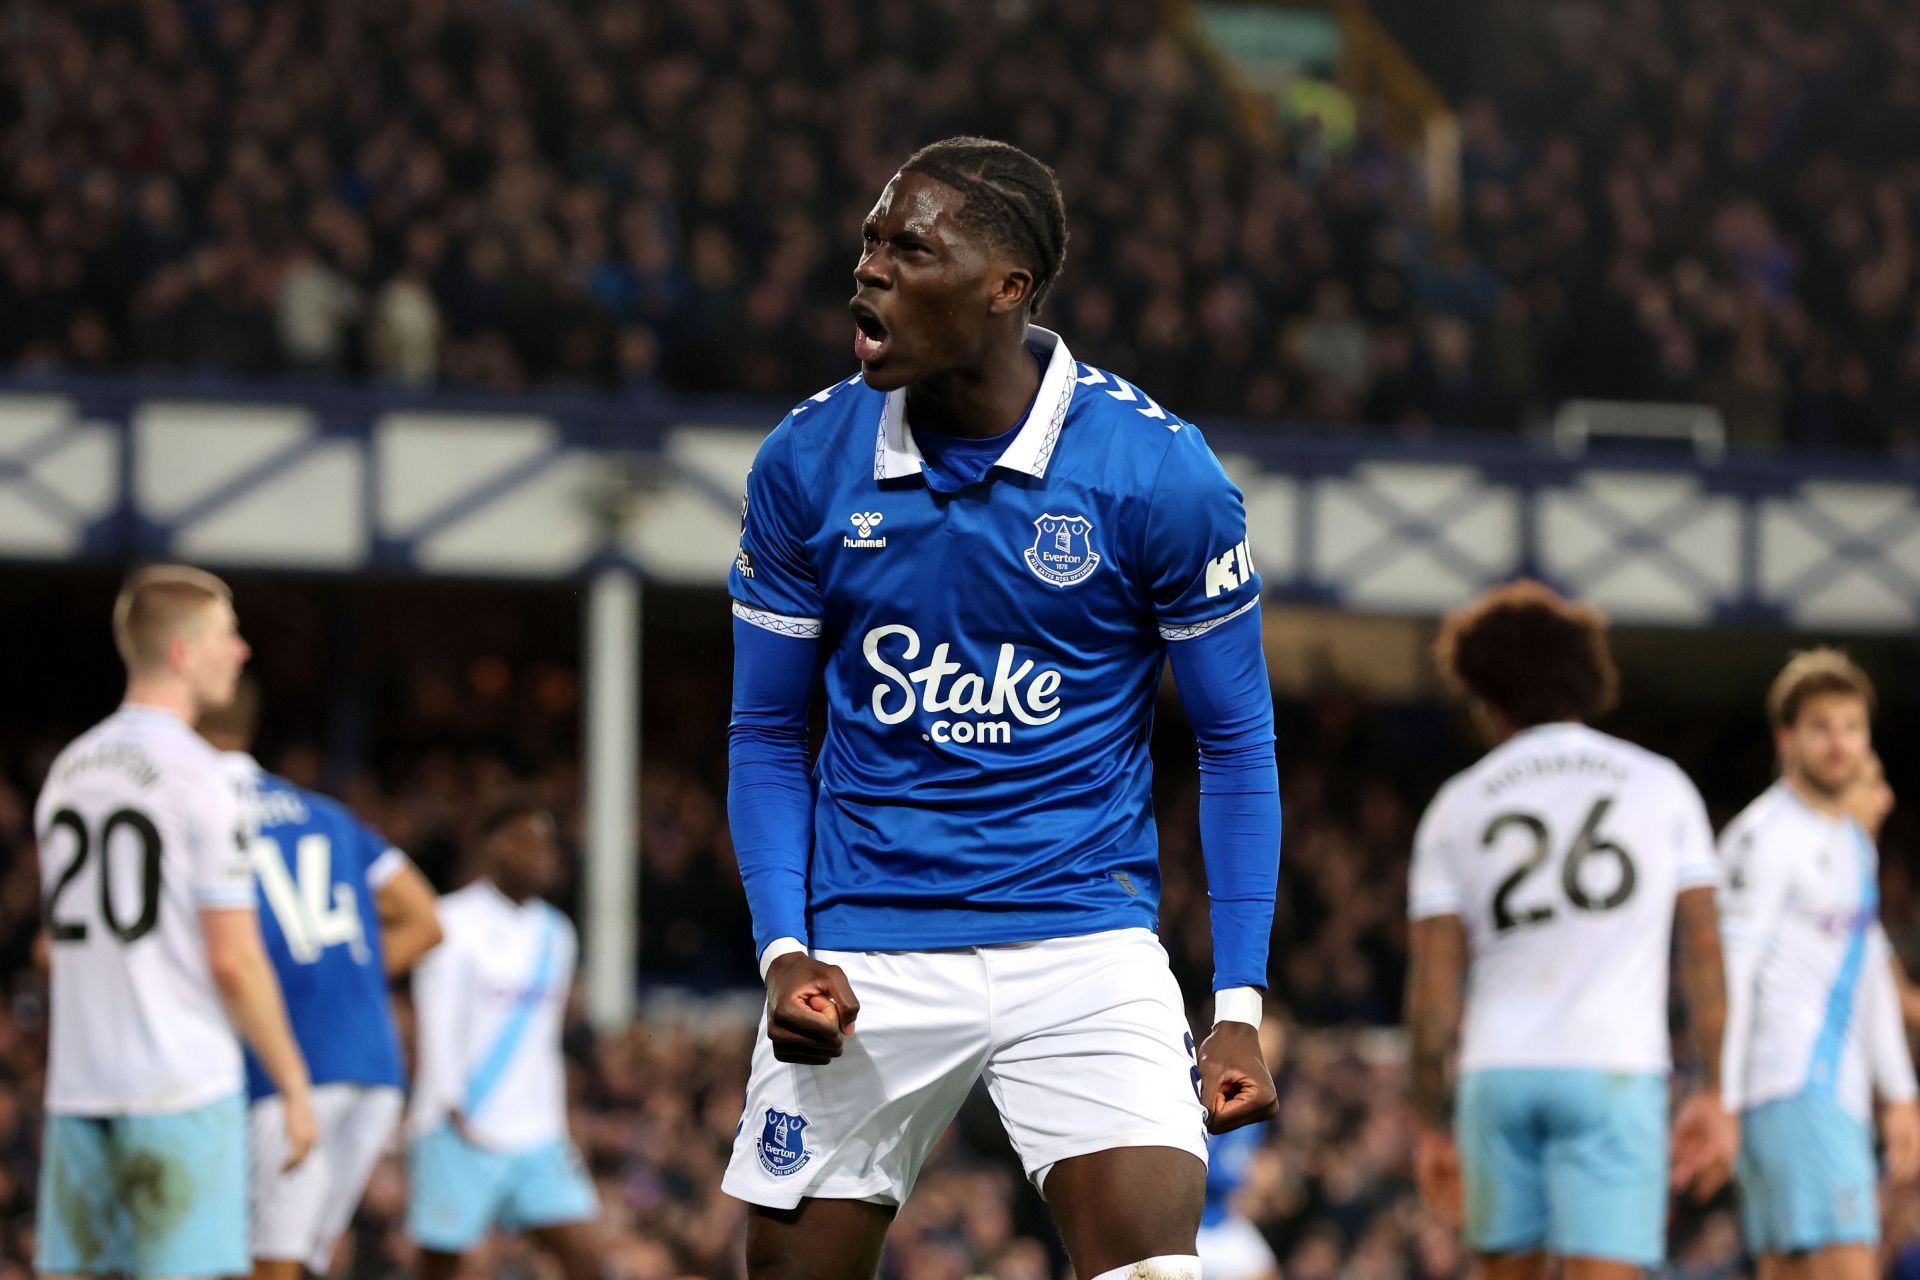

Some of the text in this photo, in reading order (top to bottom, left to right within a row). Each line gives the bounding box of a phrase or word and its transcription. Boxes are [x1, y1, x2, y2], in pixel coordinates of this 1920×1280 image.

[843, 535, 886, 548] hummel
[1043, 551, 1081, 563] Everton
[1037, 566, 1055, 580] SATIS
[1070, 562, 1094, 580] OPTIMUM
[862, 624, 1062, 726] Stake
[921, 720, 1011, 744] .com
[44, 807, 163, 943] 20
[1484, 797, 1635, 930] 26
[251, 832, 373, 966] 14
[765, 1141, 796, 1159] Everton
